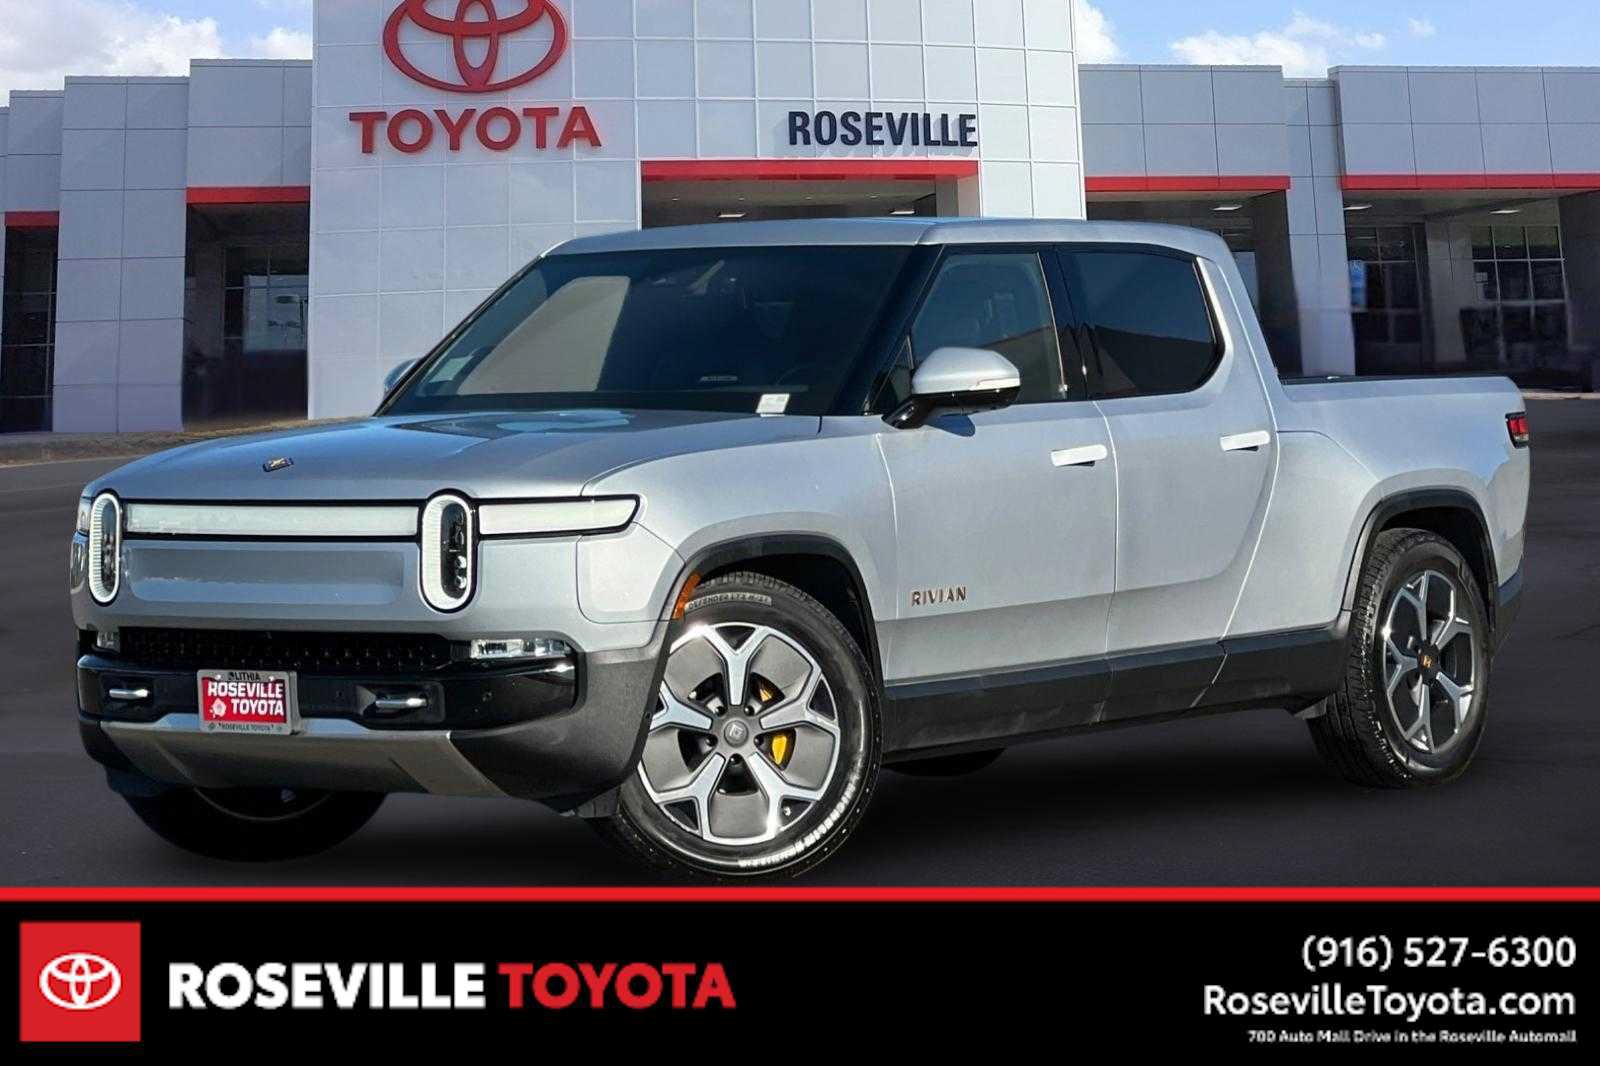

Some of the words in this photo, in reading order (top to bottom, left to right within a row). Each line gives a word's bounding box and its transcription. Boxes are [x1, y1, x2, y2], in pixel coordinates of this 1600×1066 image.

[349, 106, 602, 154] TOYOTA
[788, 111, 978, 147] ROSEVILLE
[911, 586, 967, 607] RIVIAN
[208, 681, 283, 698] ROSEVILLE
[231, 698, 284, 715] TOYOTA
